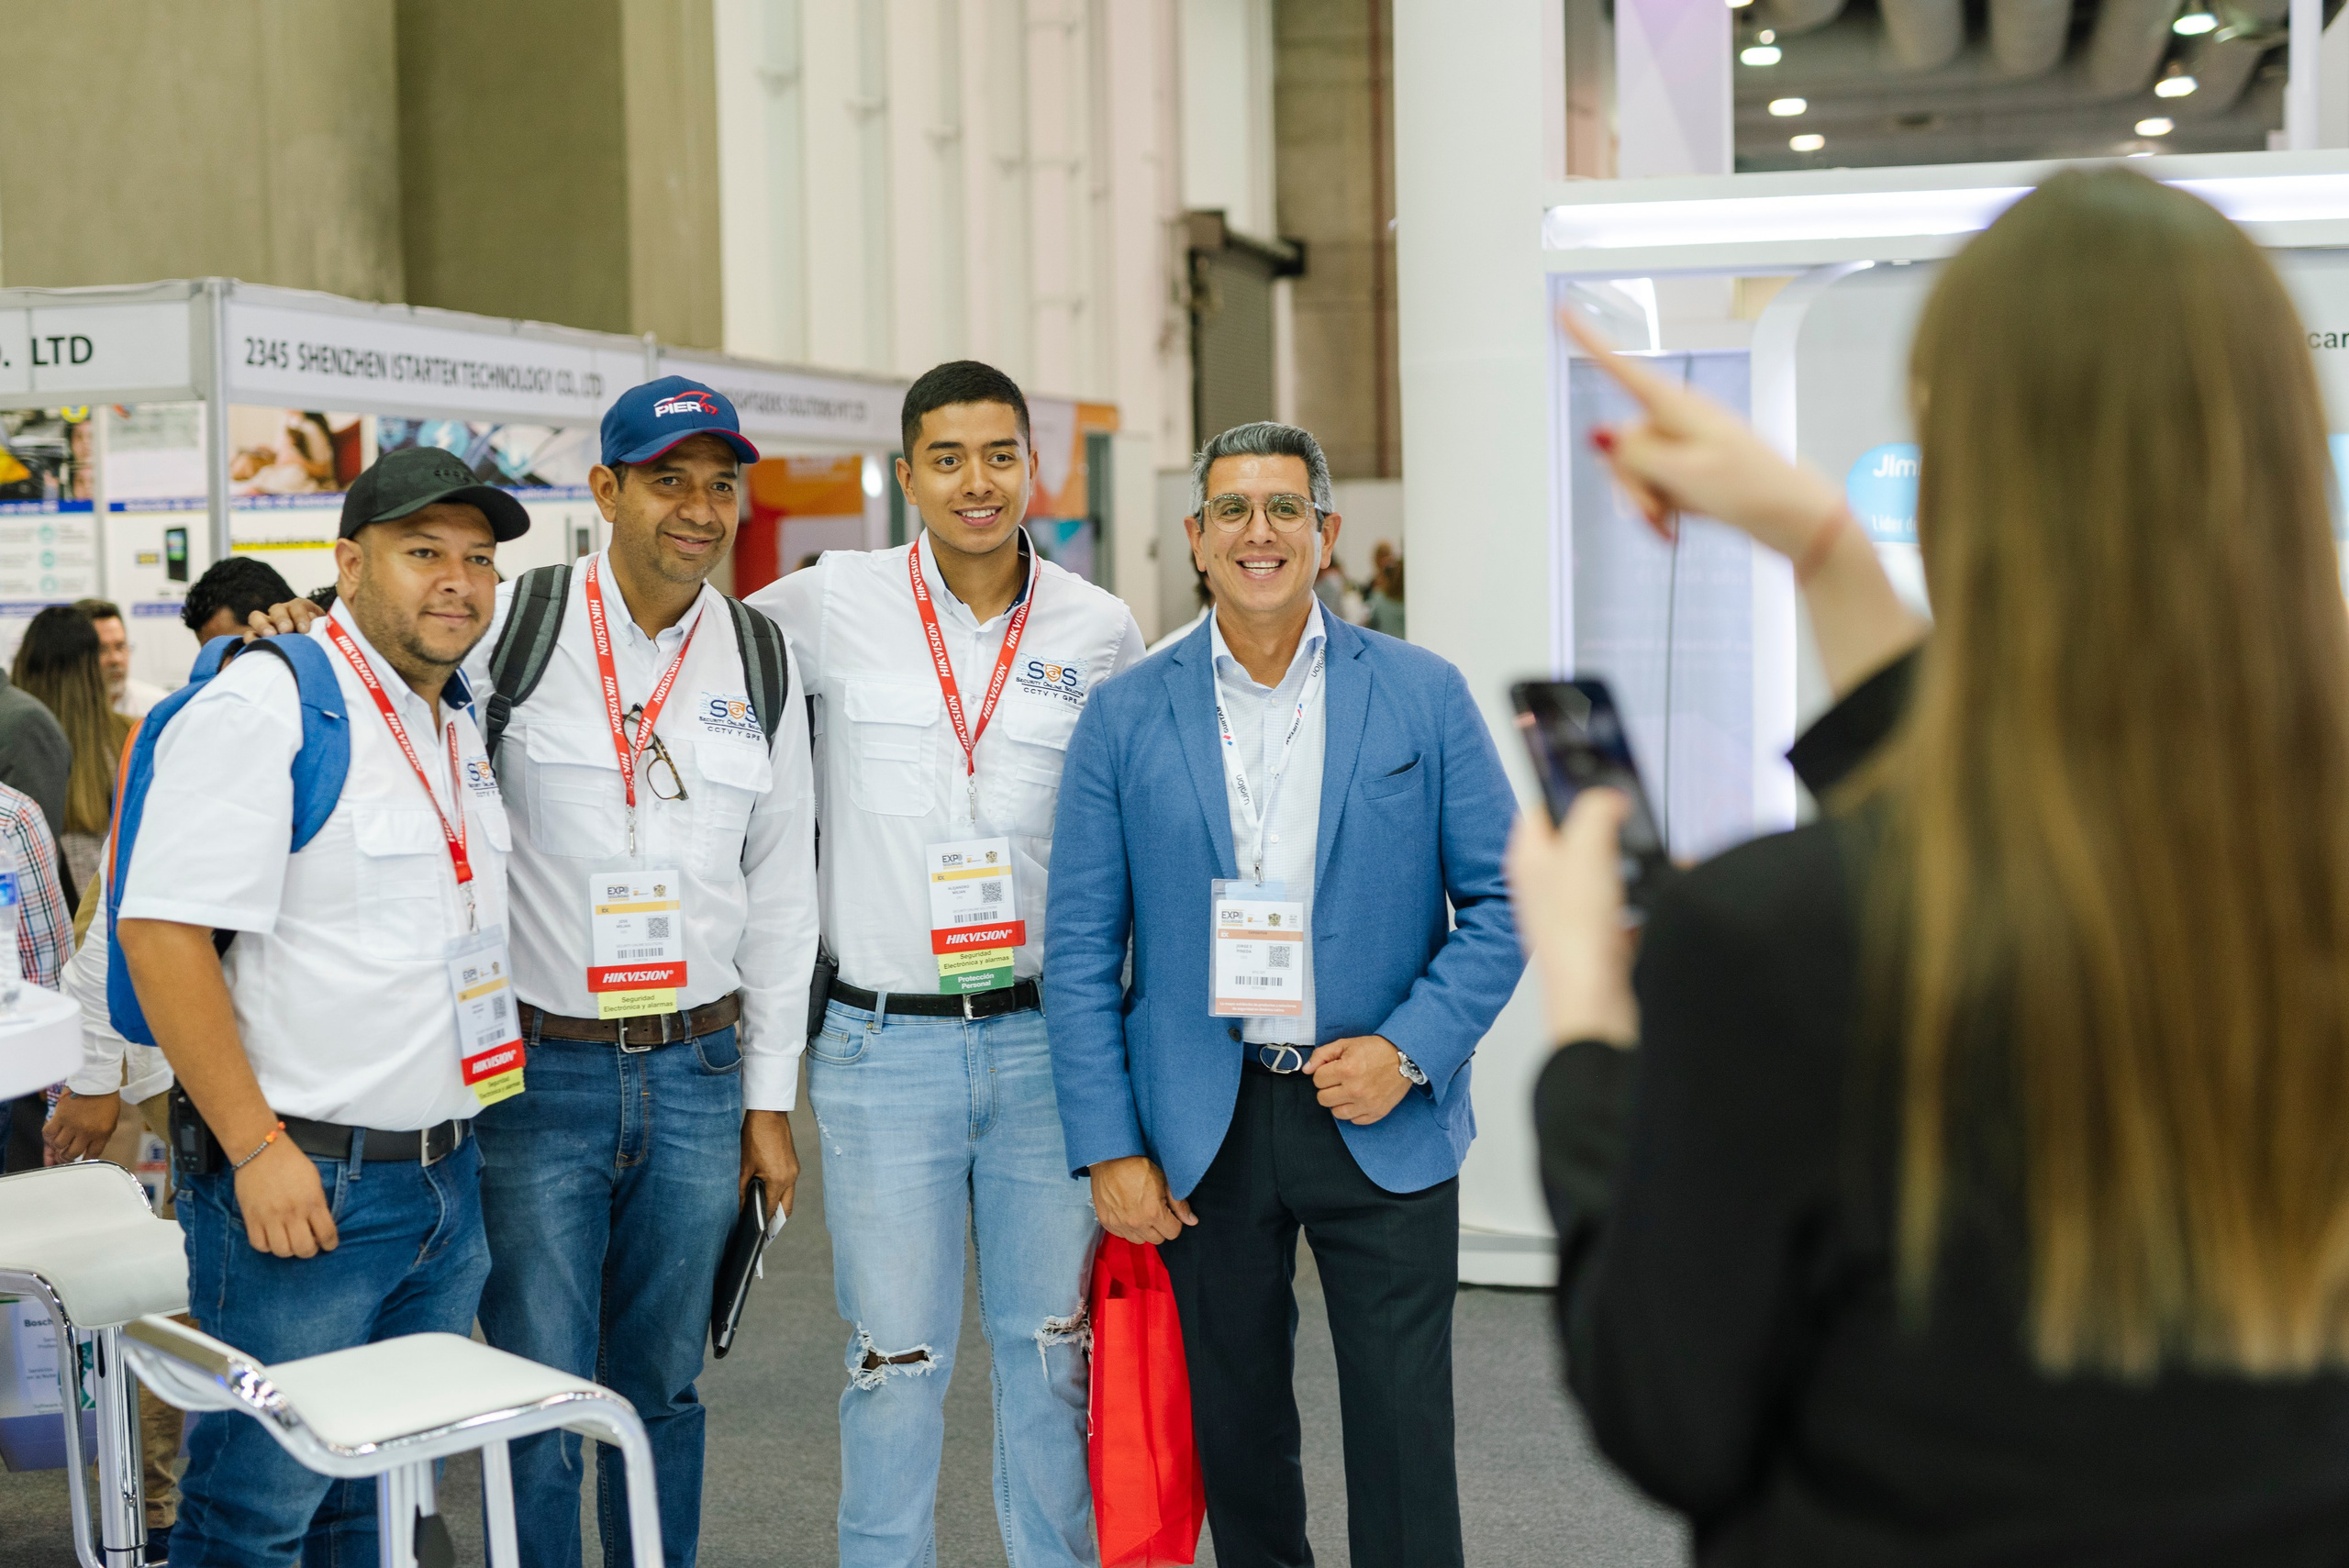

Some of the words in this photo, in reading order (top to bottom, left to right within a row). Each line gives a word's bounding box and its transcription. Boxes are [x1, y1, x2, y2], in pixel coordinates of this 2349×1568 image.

[31, 335, 93, 366] LTD
[245, 337, 288, 369] 2345
[297, 342, 387, 382] SHENZHEN
[910, 552, 928, 602] HIKVISION
[589, 599, 609, 656] HIKVISION
[336, 635, 380, 690] HIKVISION
[926, 621, 951, 677] HIKVISION
[652, 657, 682, 705] HIKVISION
[983, 662, 1008, 719] HIKVISION
[604, 675, 623, 735] HIKVISION
[1023, 687, 1049, 696] CCTV
[1063, 695, 1077, 704] GPS
[707, 726, 733, 735] CCTV
[947, 694, 971, 751] HIKVISION
[1216, 706, 1230, 733] GURTAM
[385, 712, 422, 772] HIKVISION
[946, 929, 1008, 944] HIKVISION
[943, 961, 978, 970] Electrónica
[985, 955, 1009, 963] alarmas
[960, 951, 991, 960] Seguridad
[602, 970, 670, 984] HIKVISION
[958, 973, 994, 983] Protección
[962, 980, 991, 989] Personal
[604, 1004, 640, 1013] Electrónica
[621, 995, 655, 1004] Seguridad
[24, 1318, 53, 1328] Bosch
